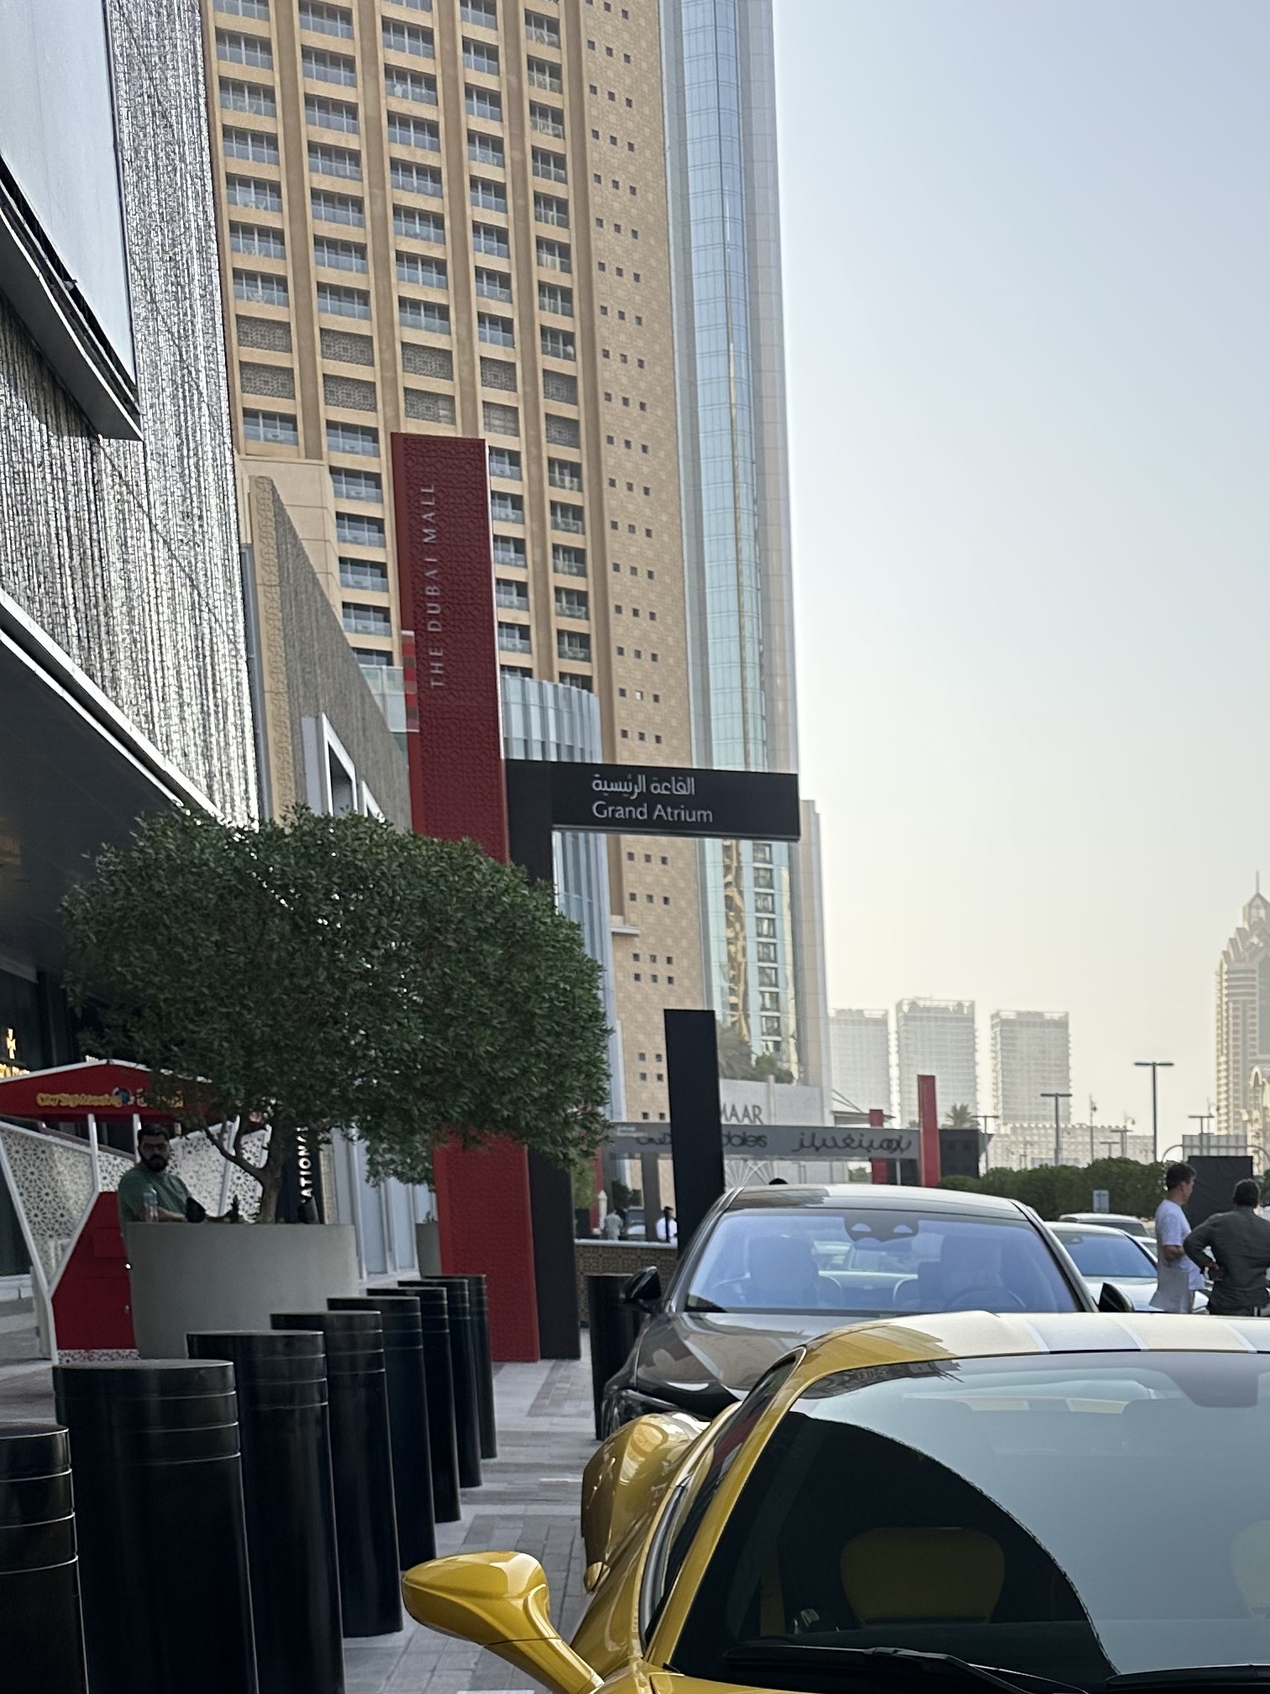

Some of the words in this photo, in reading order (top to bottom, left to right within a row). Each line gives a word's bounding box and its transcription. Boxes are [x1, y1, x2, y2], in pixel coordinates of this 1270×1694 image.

[419, 484, 437, 544] MALL
[424, 557, 442, 632] DUBAI
[429, 647, 446, 689] THE
[591, 773, 647, 800] الرئيسية
[650, 776, 696, 796] القاعة
[592, 801, 648, 820] Grand
[653, 804, 713, 823] Atrium
[721, 1103, 765, 1125] MAAR
